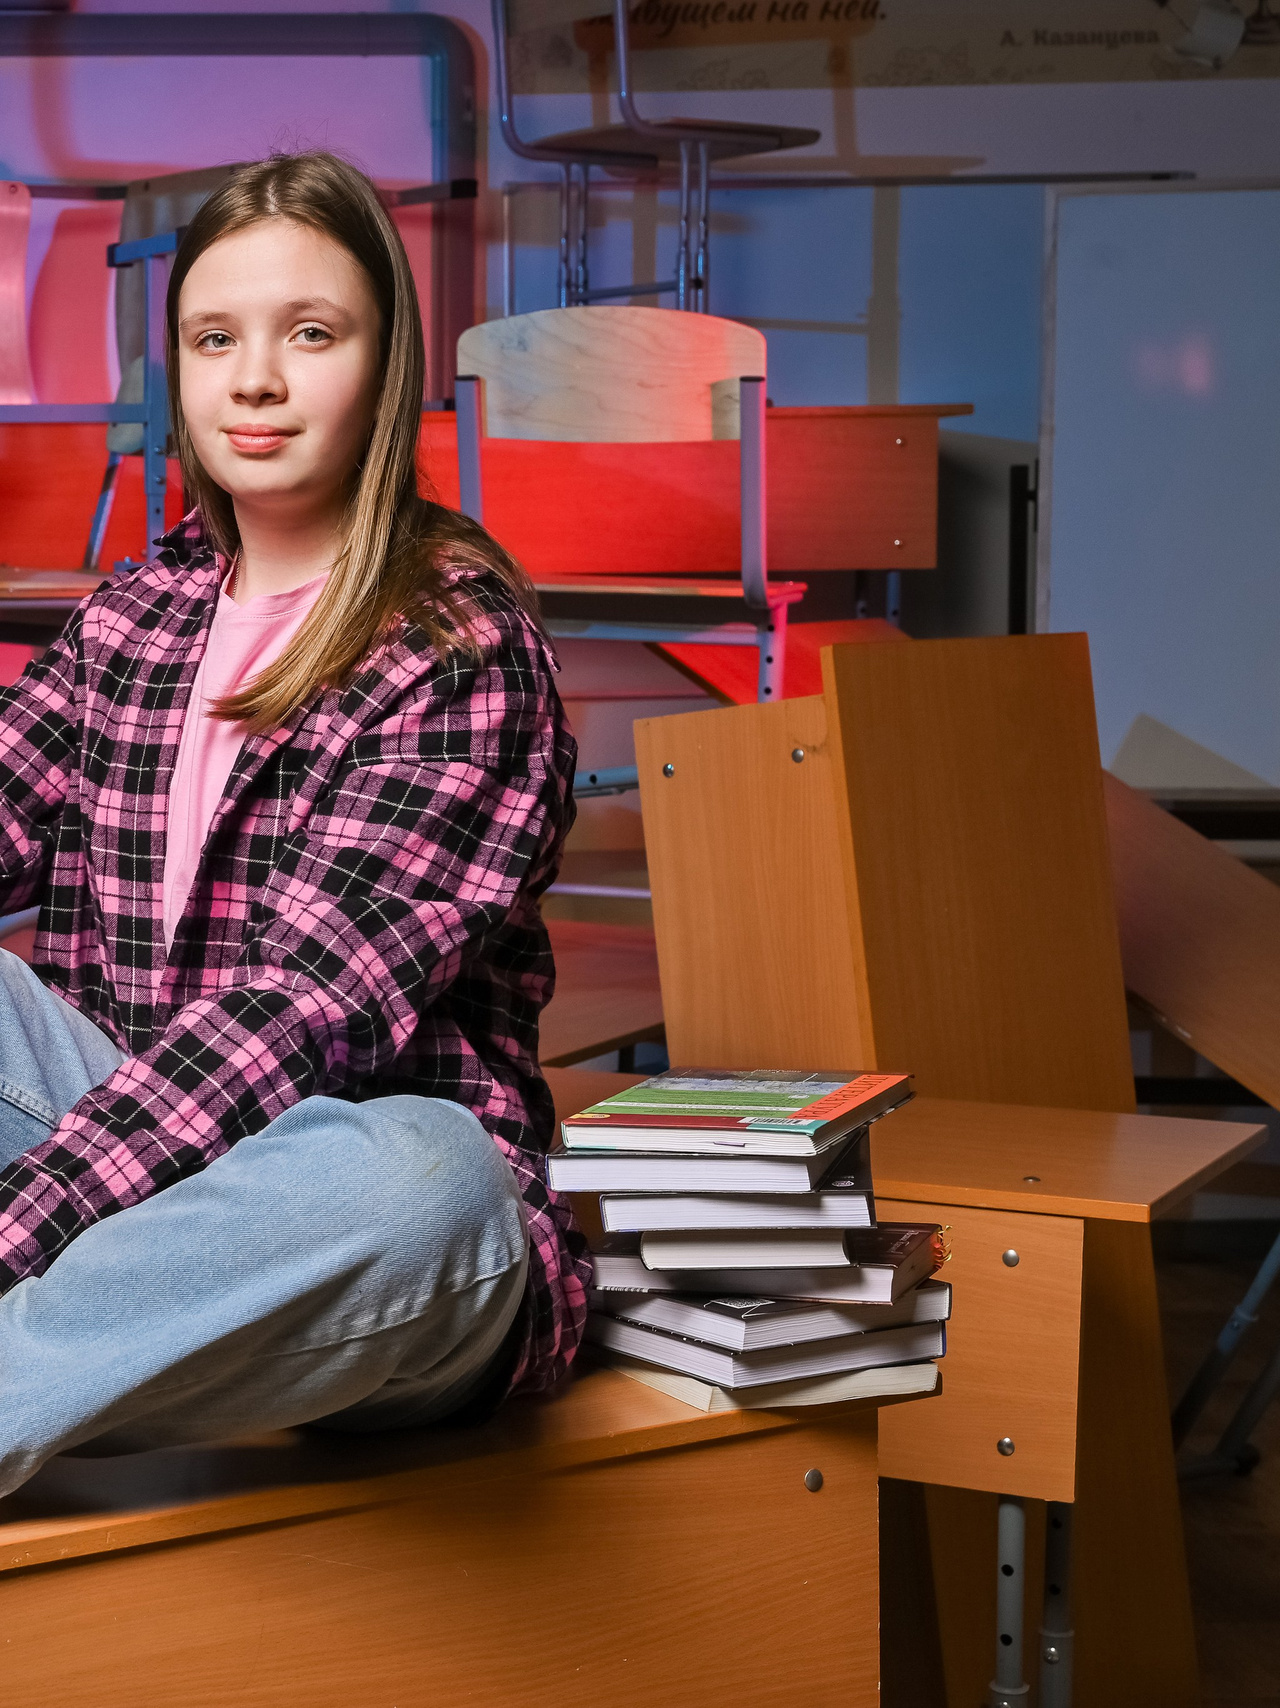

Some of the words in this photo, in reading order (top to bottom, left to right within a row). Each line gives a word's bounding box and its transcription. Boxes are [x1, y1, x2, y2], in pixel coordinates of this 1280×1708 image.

[767, 0, 808, 22] на
[1000, 29, 1022, 47] А.
[1033, 29, 1160, 50] Казанцева
[793, 1075, 890, 1119] ЛИТЕРАТУРА
